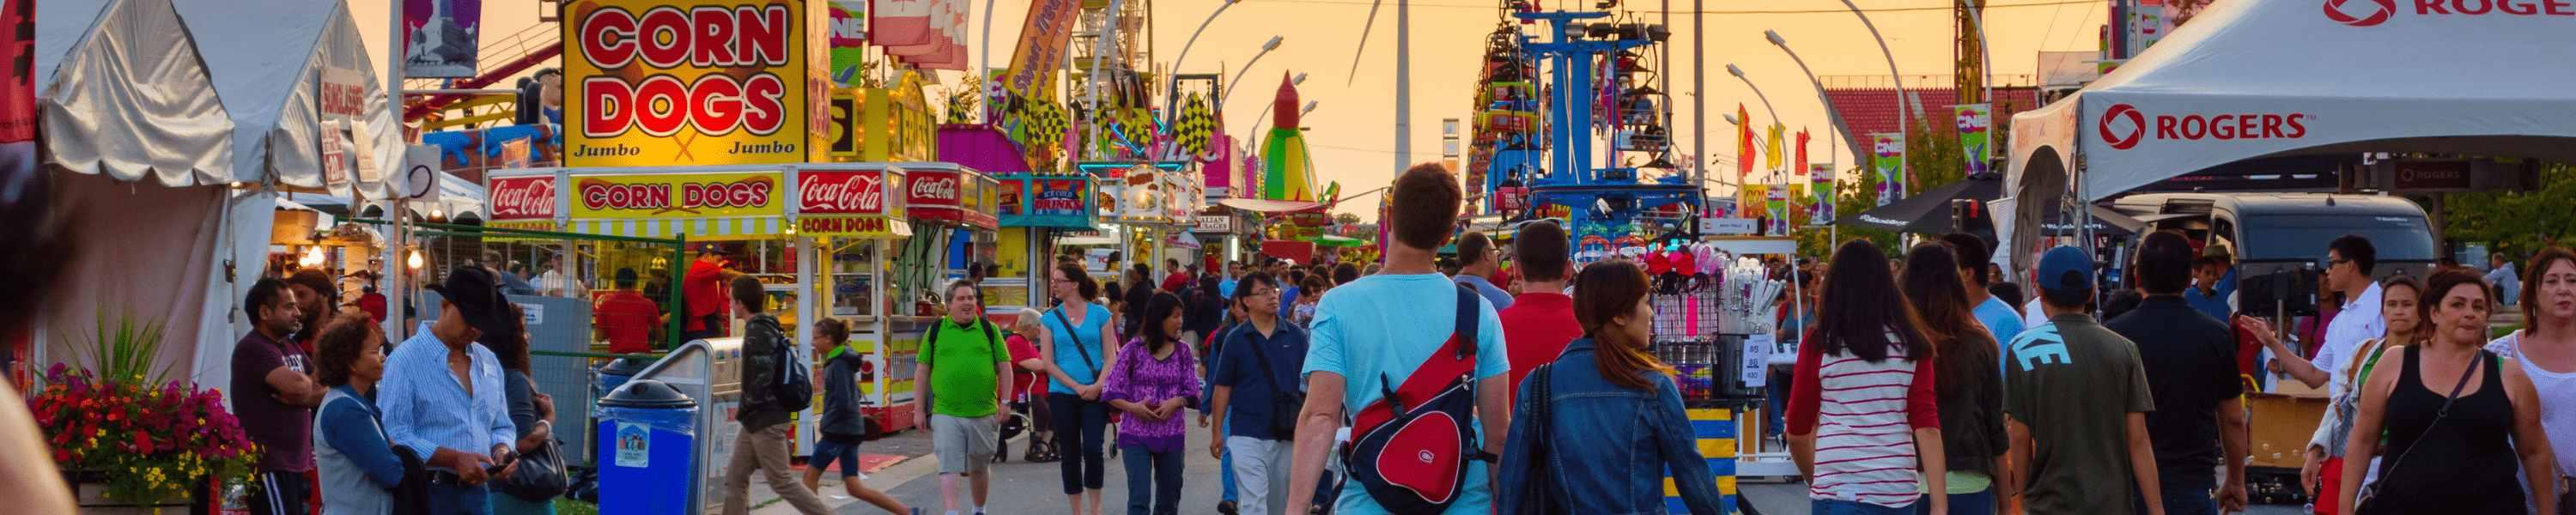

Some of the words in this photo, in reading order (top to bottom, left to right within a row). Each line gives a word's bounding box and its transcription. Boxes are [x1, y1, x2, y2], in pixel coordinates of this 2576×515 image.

[2414, 0, 2576, 15] ROGE
[580, 6, 789, 69] CORN
[829, 17, 864, 39] NE
[583, 74, 786, 137] DOGS
[2156, 113, 2306, 141] ROGERS
[574, 144, 641, 158] Jumbo
[728, 141, 796, 154] Jumbo
[582, 184, 671, 210] CORN
[682, 181, 769, 209] DOGS
[799, 174, 882, 211] Coca-Cola
[801, 218, 842, 233] CORN
[845, 217, 885, 233] DOGS
